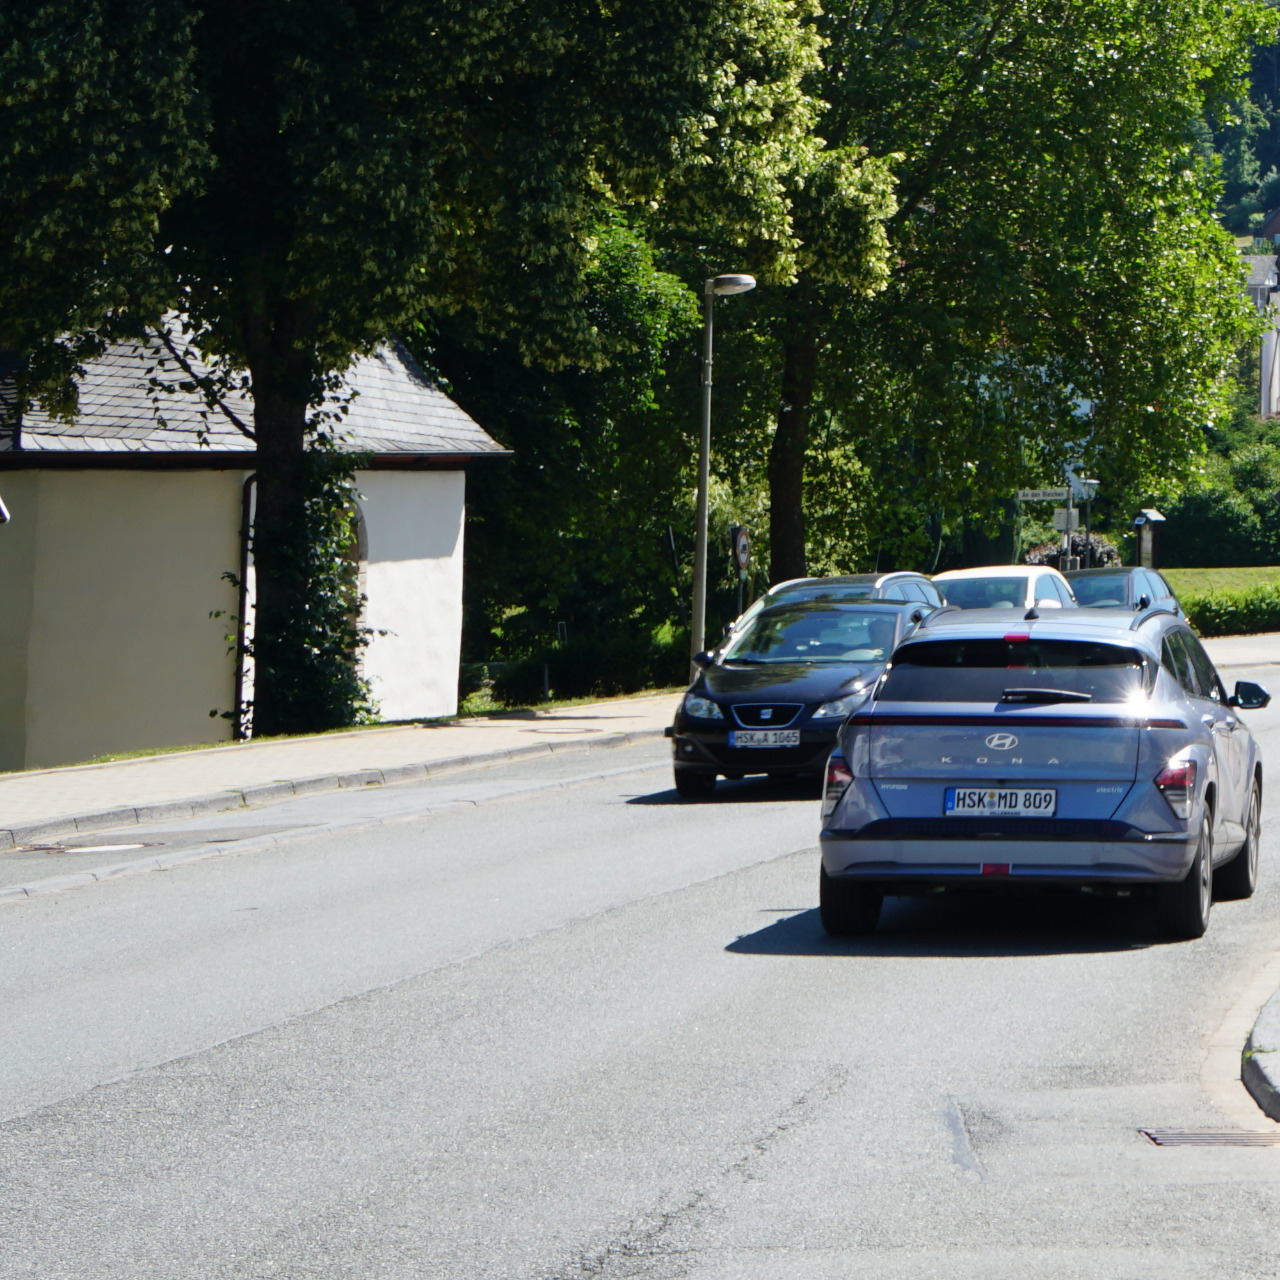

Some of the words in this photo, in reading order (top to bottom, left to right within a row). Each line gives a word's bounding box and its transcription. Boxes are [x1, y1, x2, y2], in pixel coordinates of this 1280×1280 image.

[736, 732, 756, 743] HSK
[941, 756, 1060, 765] KONA
[956, 791, 987, 808] HSK
[998, 792, 1018, 808] MD
[1023, 792, 1052, 809] 809
